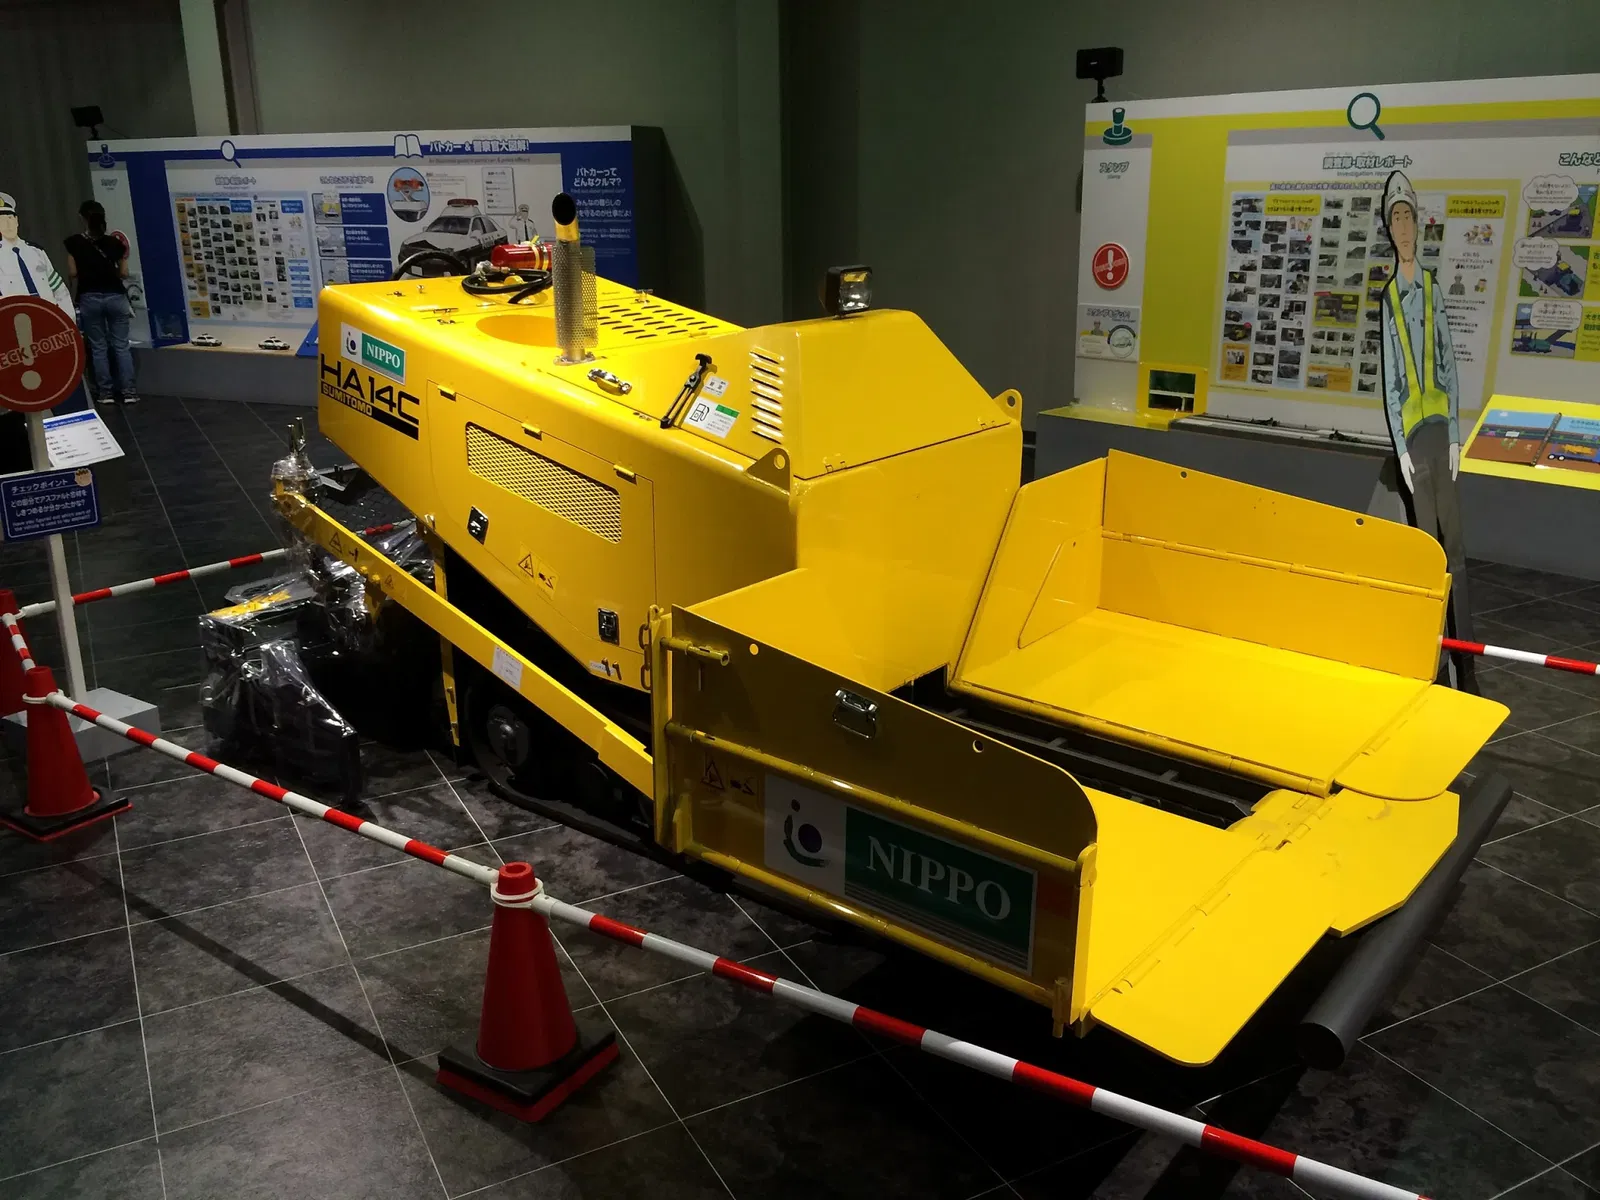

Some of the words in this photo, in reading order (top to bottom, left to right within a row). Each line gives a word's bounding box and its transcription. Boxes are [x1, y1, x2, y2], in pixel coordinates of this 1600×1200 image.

[429, 141, 462, 152] パトカー
[464, 142, 471, 152] &
[576, 167, 618, 177] パトカーって
[1099, 161, 1129, 173] スタンプ
[573, 178, 622, 187] どんなクルマ?
[30, 329, 75, 358] POINT
[366, 342, 401, 369] NIPPO
[322, 382, 373, 417] SUMITOMO
[11, 478, 69, 494] チェックポイント
[866, 836, 1012, 922] NIPPO
